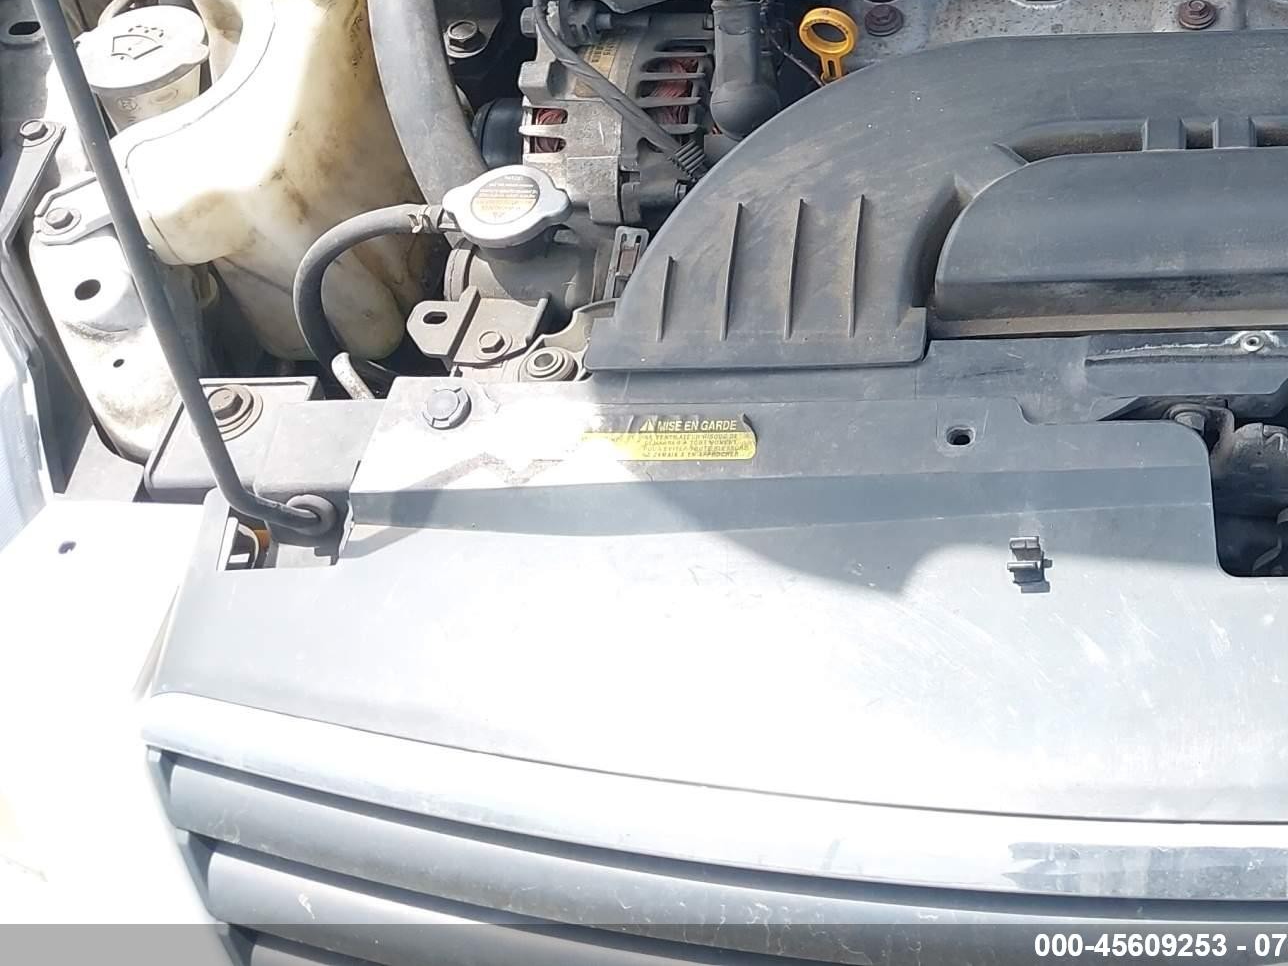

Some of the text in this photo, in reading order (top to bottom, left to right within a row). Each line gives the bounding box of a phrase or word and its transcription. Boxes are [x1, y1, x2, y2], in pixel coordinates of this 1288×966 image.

[657, 420, 737, 431] MISE EN GARDE
